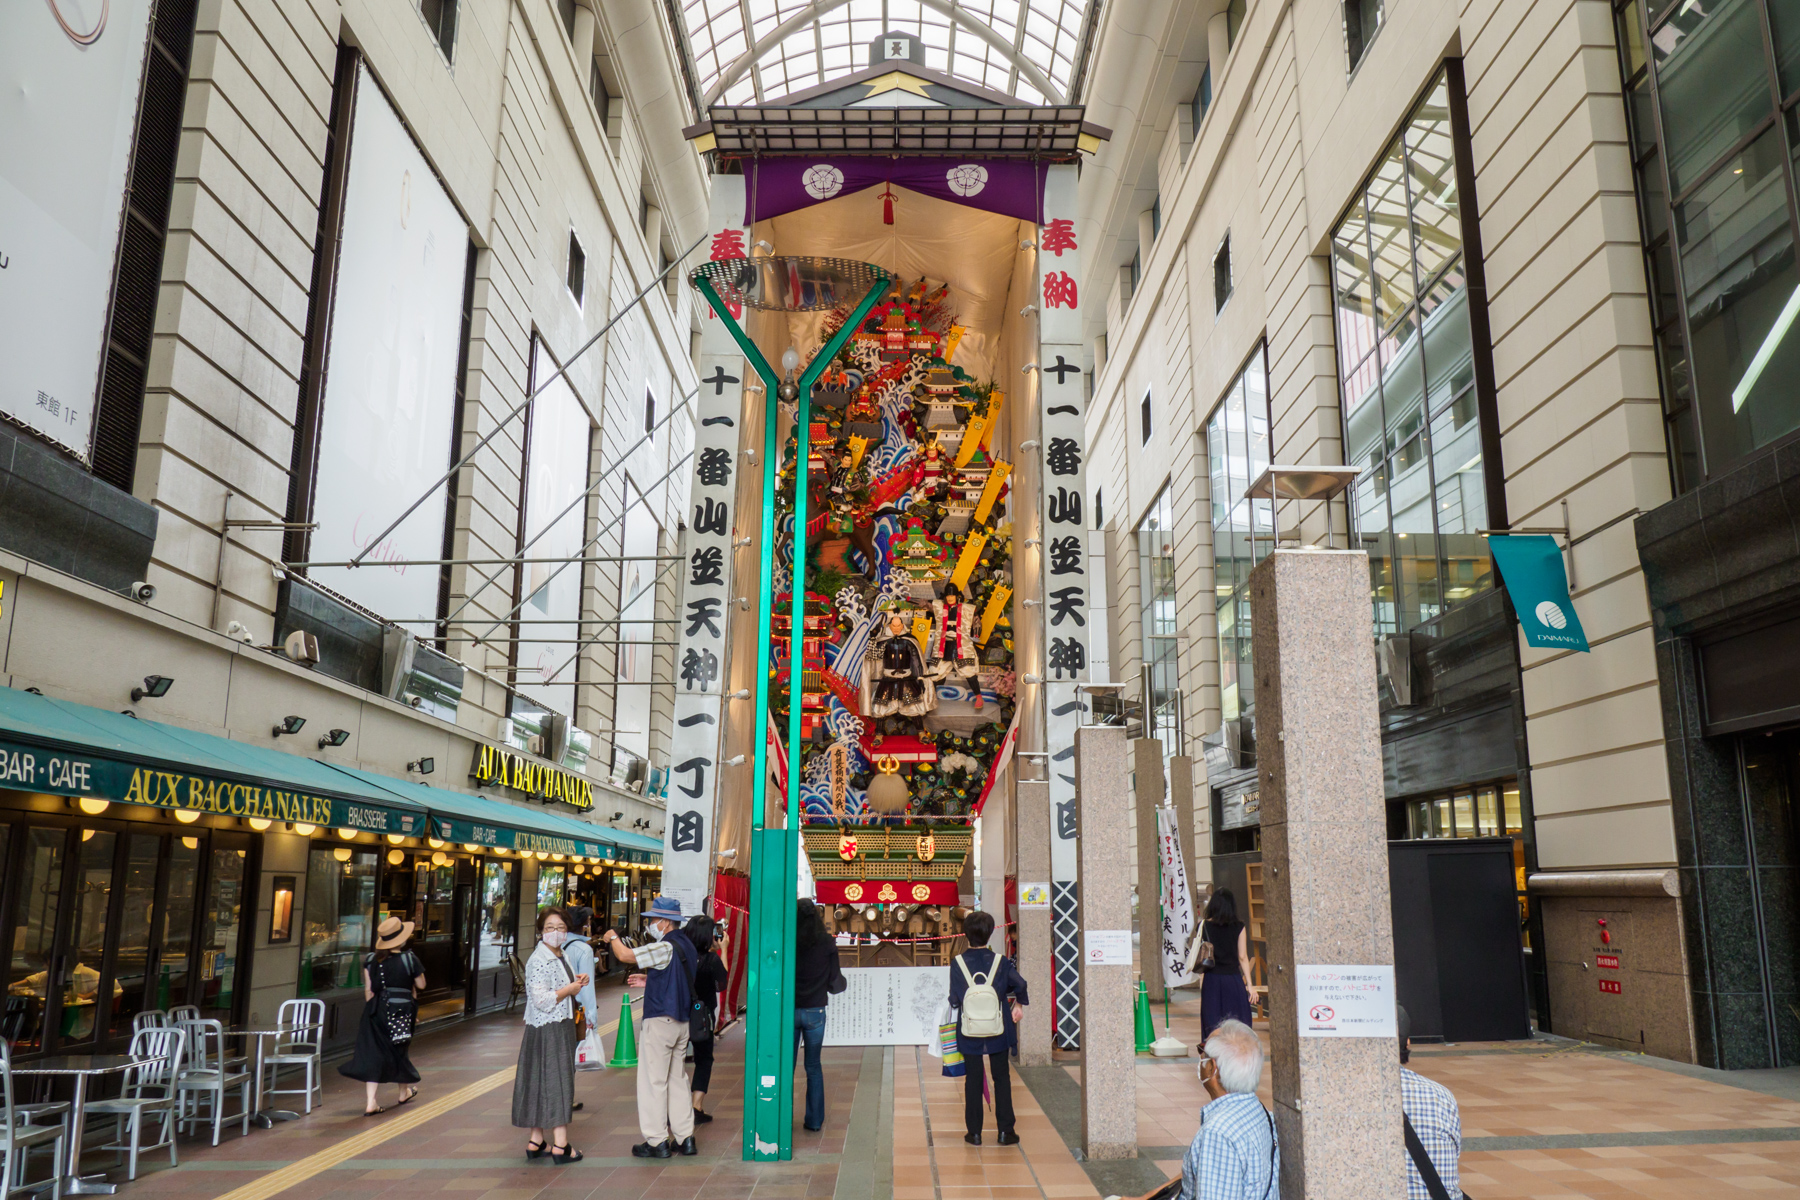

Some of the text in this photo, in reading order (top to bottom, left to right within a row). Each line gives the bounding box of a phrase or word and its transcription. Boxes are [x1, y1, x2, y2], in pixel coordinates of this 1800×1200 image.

[1041, 218, 1078, 310] 奉納
[36, 390, 78, 425] 東館 1F
[352, 510, 411, 577] Cartier
[1537, 634, 1580, 645] DAIMARU
[0, 749, 91, 791] BAR CAFE
[476, 744, 594, 808] AUX BACCHANALES
[124, 767, 332, 826] AUX BACCHANALES
[348, 806, 387, 830] BRASSERIE
[472, 826, 497, 844] BAR CAFE
[514, 832, 576, 855] AUX BACCHANALES
[1164, 835, 1174, 866] マスク
